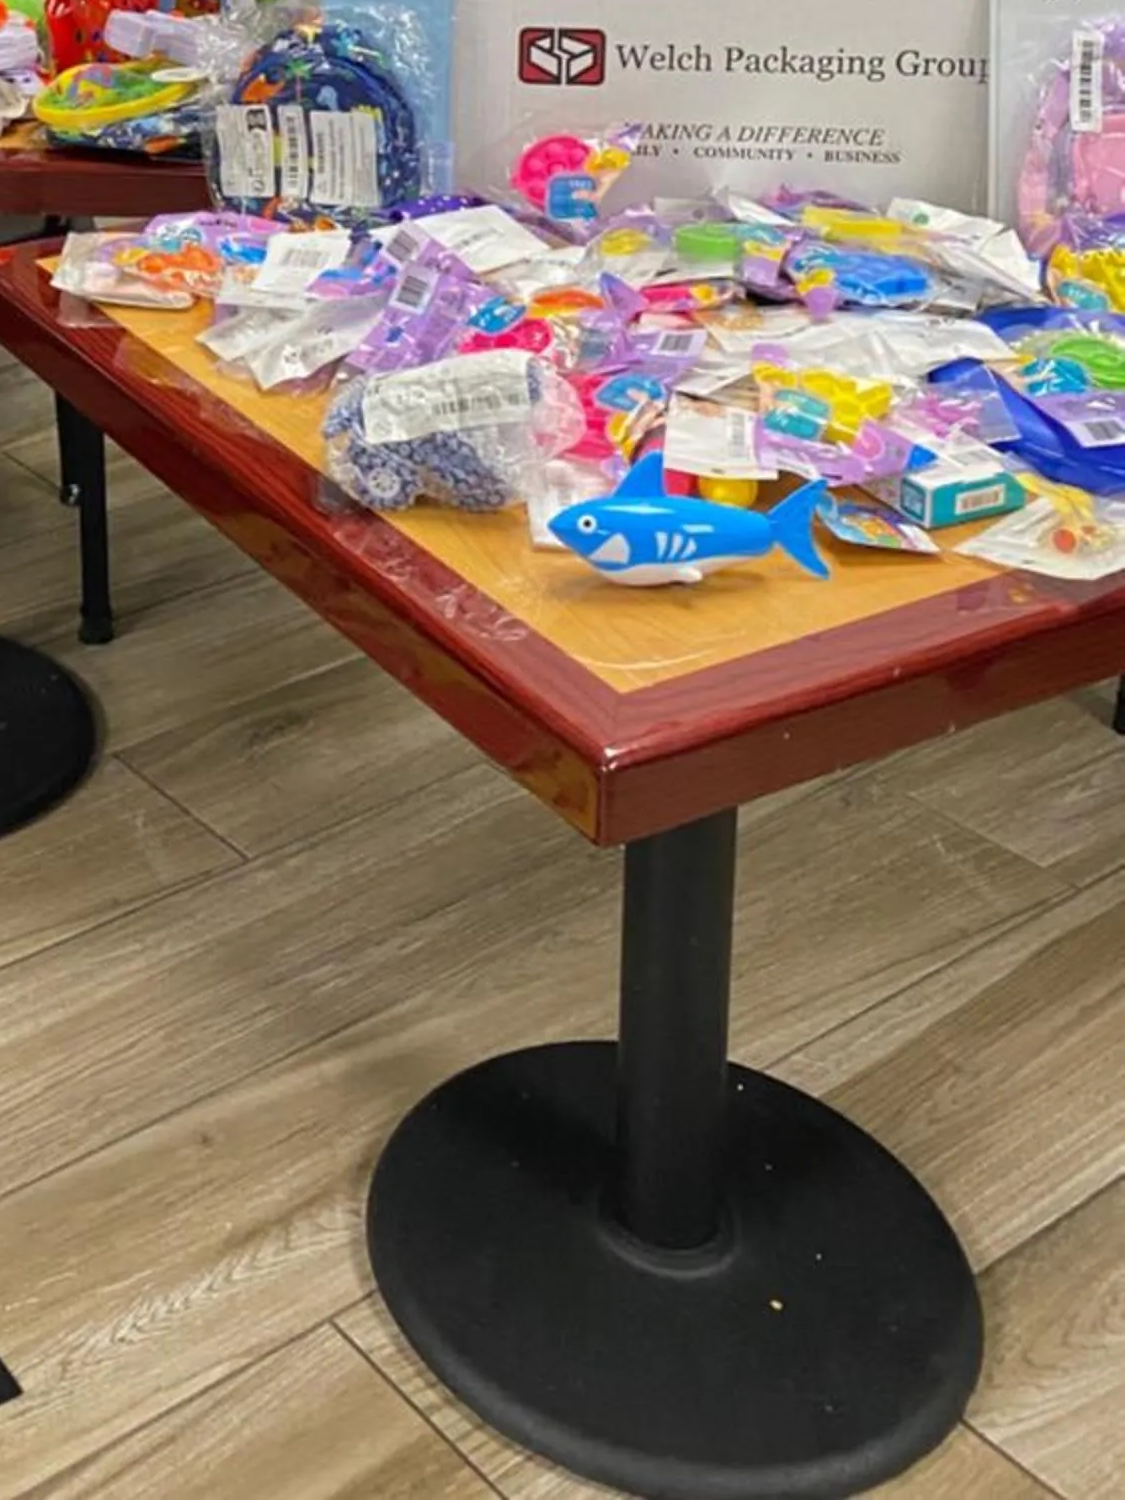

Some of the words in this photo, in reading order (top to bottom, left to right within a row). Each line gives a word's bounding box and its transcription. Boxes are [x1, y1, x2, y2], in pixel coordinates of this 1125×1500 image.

[615, 43, 713, 73] Welch
[725, 45, 887, 83] Packaging
[619, 121, 713, 142] AKING
[716, 125, 733, 143] A
[736, 124, 887, 148] DIFFERENCE
[692, 145, 795, 162] COMMUNITY
[823, 149, 902, 165] BUSINESS
